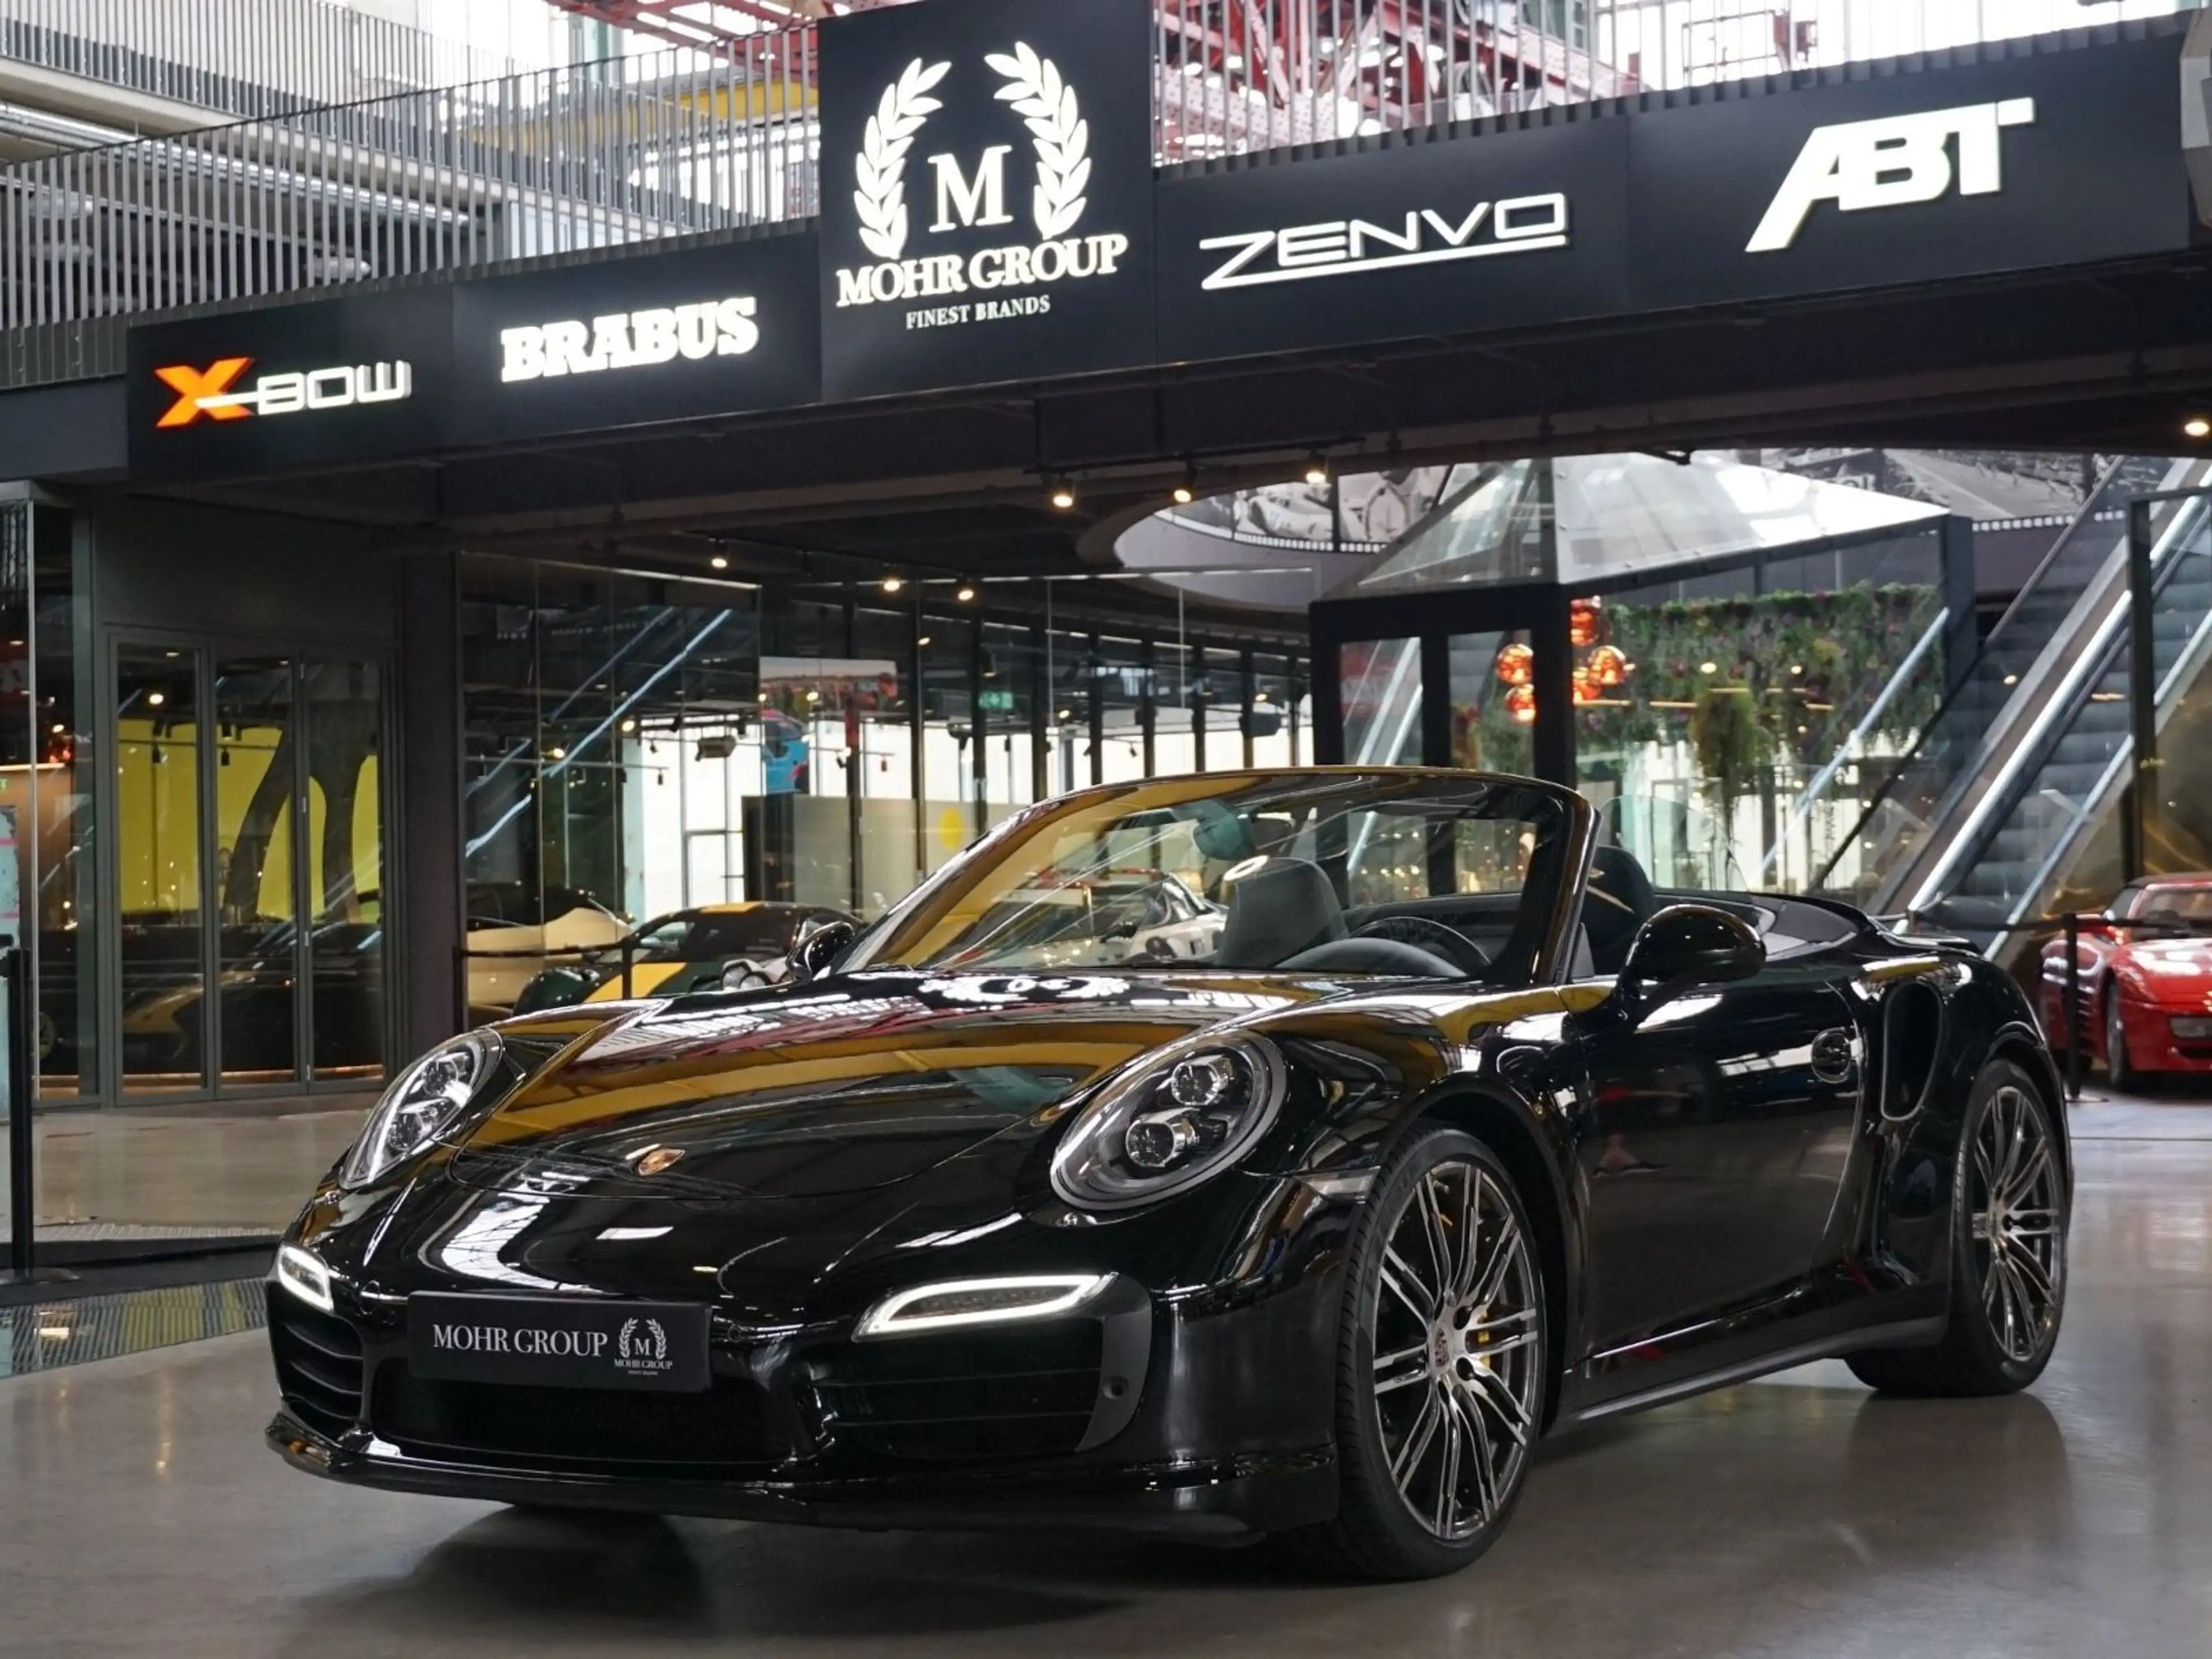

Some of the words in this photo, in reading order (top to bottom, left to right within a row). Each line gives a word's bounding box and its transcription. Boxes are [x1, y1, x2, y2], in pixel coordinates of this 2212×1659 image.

[927, 145, 1014, 233] M
[1745, 97, 2035, 253] ABT
[835, 254, 968, 308] MOHR
[969, 233, 1128, 289] GROUP
[1199, 192, 1567, 291] ZENVO
[500, 296, 759, 383] BRABUS
[906, 304, 971, 329] FINEST
[975, 294, 1051, 321] BRANDS
[433, 1324, 511, 1353] MOHR
[514, 1328, 608, 1357] GROUP
[634, 1338, 651, 1356] M
[641, 1359, 673, 1370] GROUP
